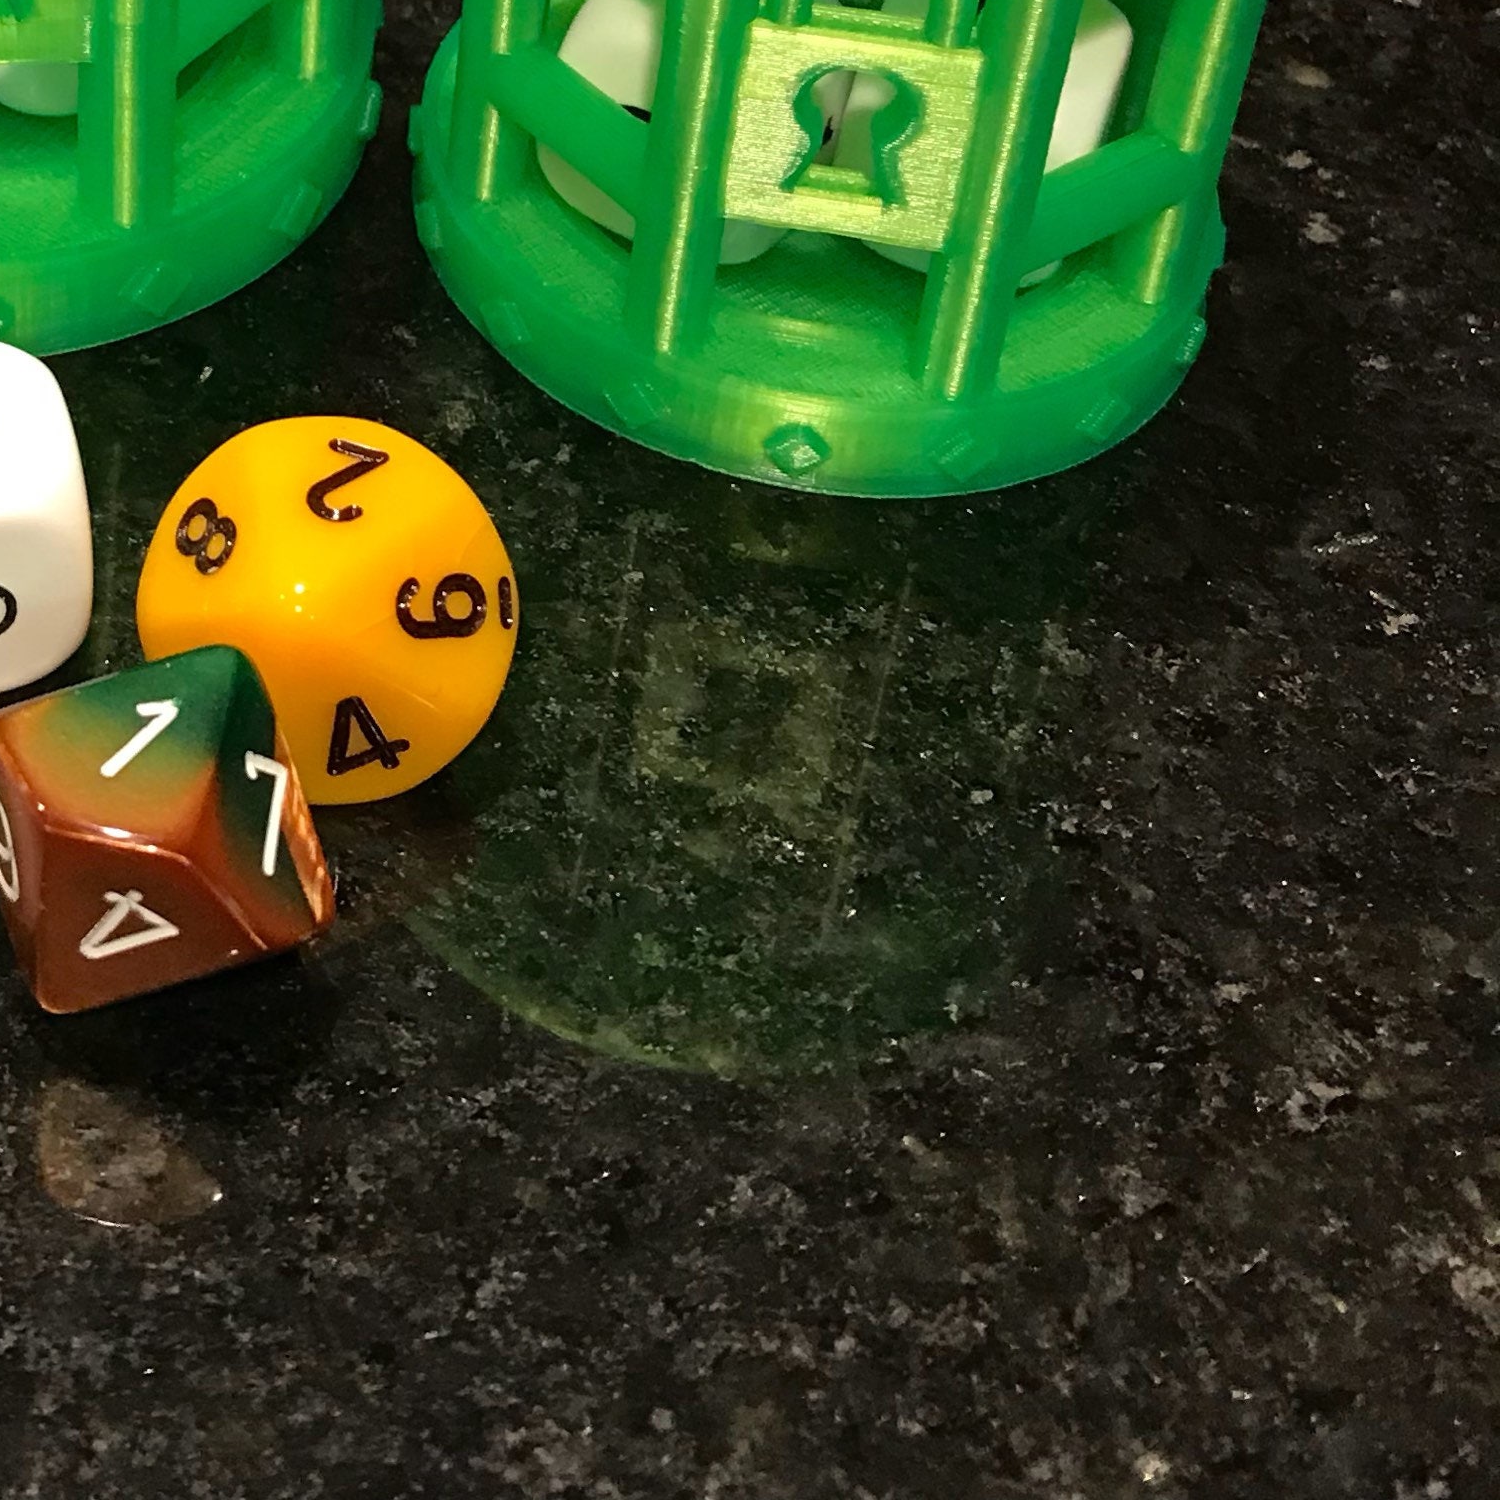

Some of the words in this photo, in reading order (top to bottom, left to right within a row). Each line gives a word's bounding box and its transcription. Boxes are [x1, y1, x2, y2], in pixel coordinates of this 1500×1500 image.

[306, 439, 390, 522] 2
[175, 497, 237, 576] 8
[100, 699, 179, 778] 1
[325, 695, 411, 777] 4
[245, 751, 288, 876] 7
[79, 890, 180, 959] 4
